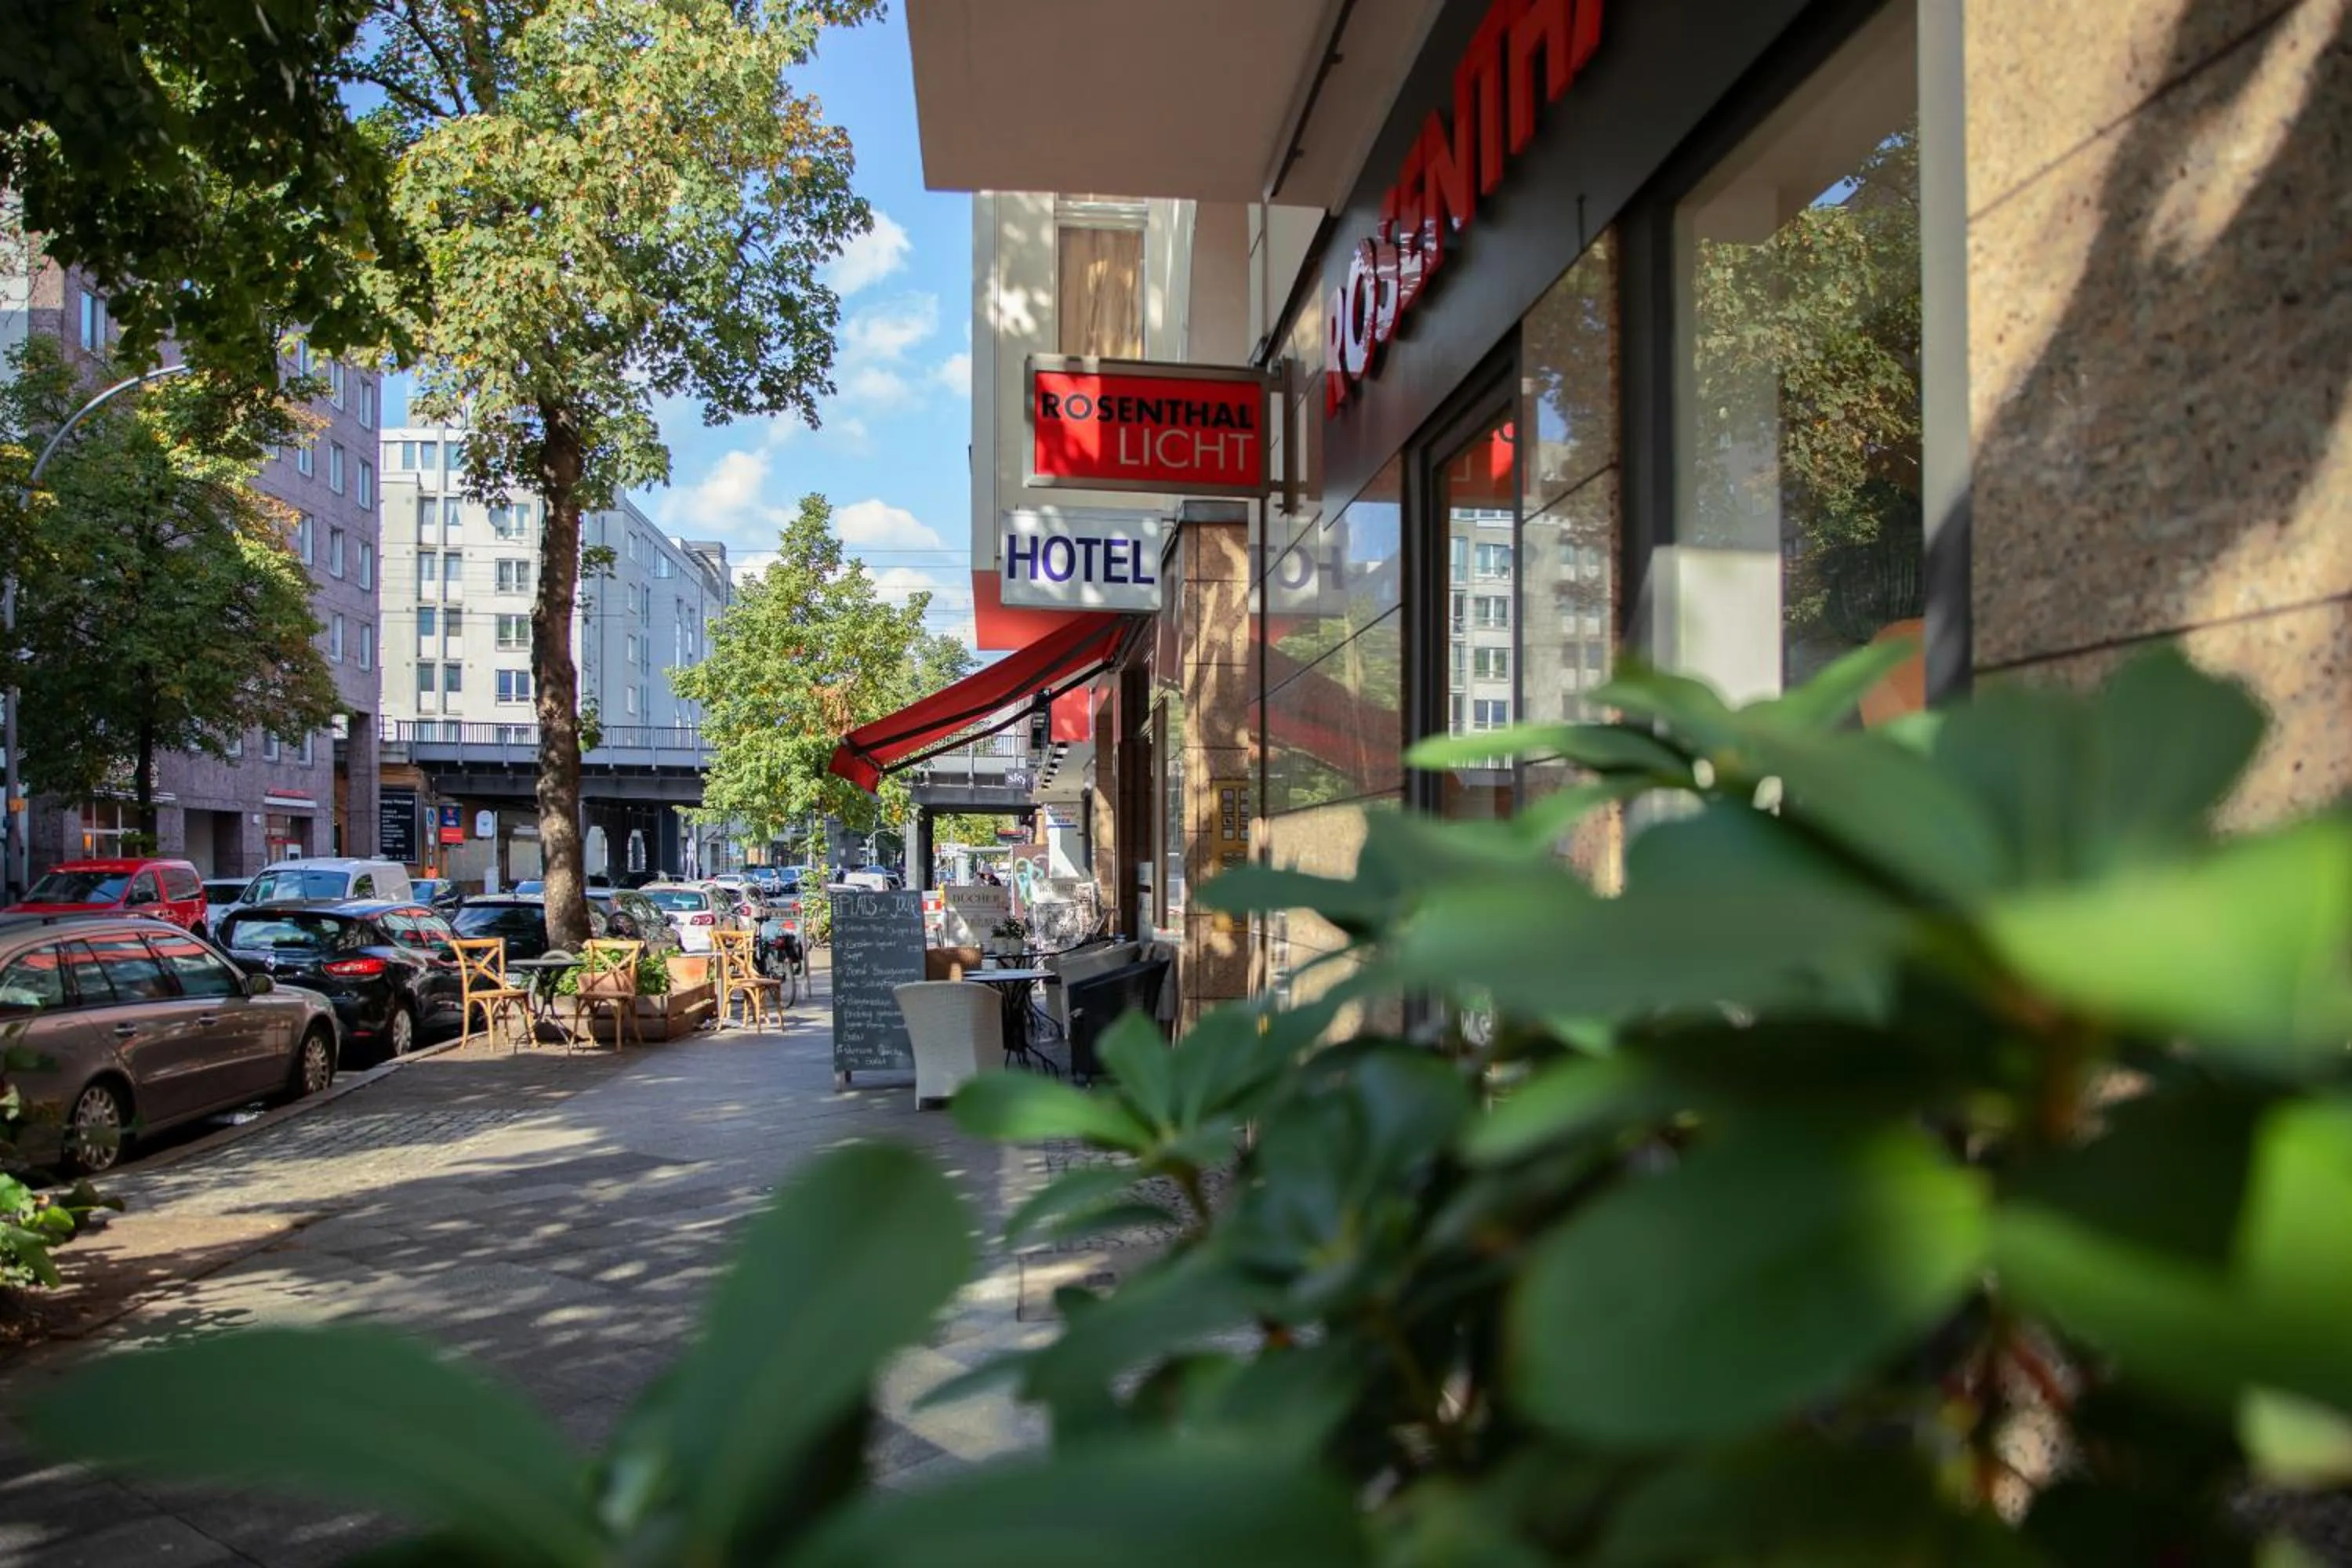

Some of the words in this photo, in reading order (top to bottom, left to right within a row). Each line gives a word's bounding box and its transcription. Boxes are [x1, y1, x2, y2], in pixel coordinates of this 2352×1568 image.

[1041, 393, 1254, 430] ROSENTHAL
[1119, 426, 1254, 471] LICHT
[1007, 534, 1155, 585] HOTEL
[1007, 772, 1026, 785] sky
